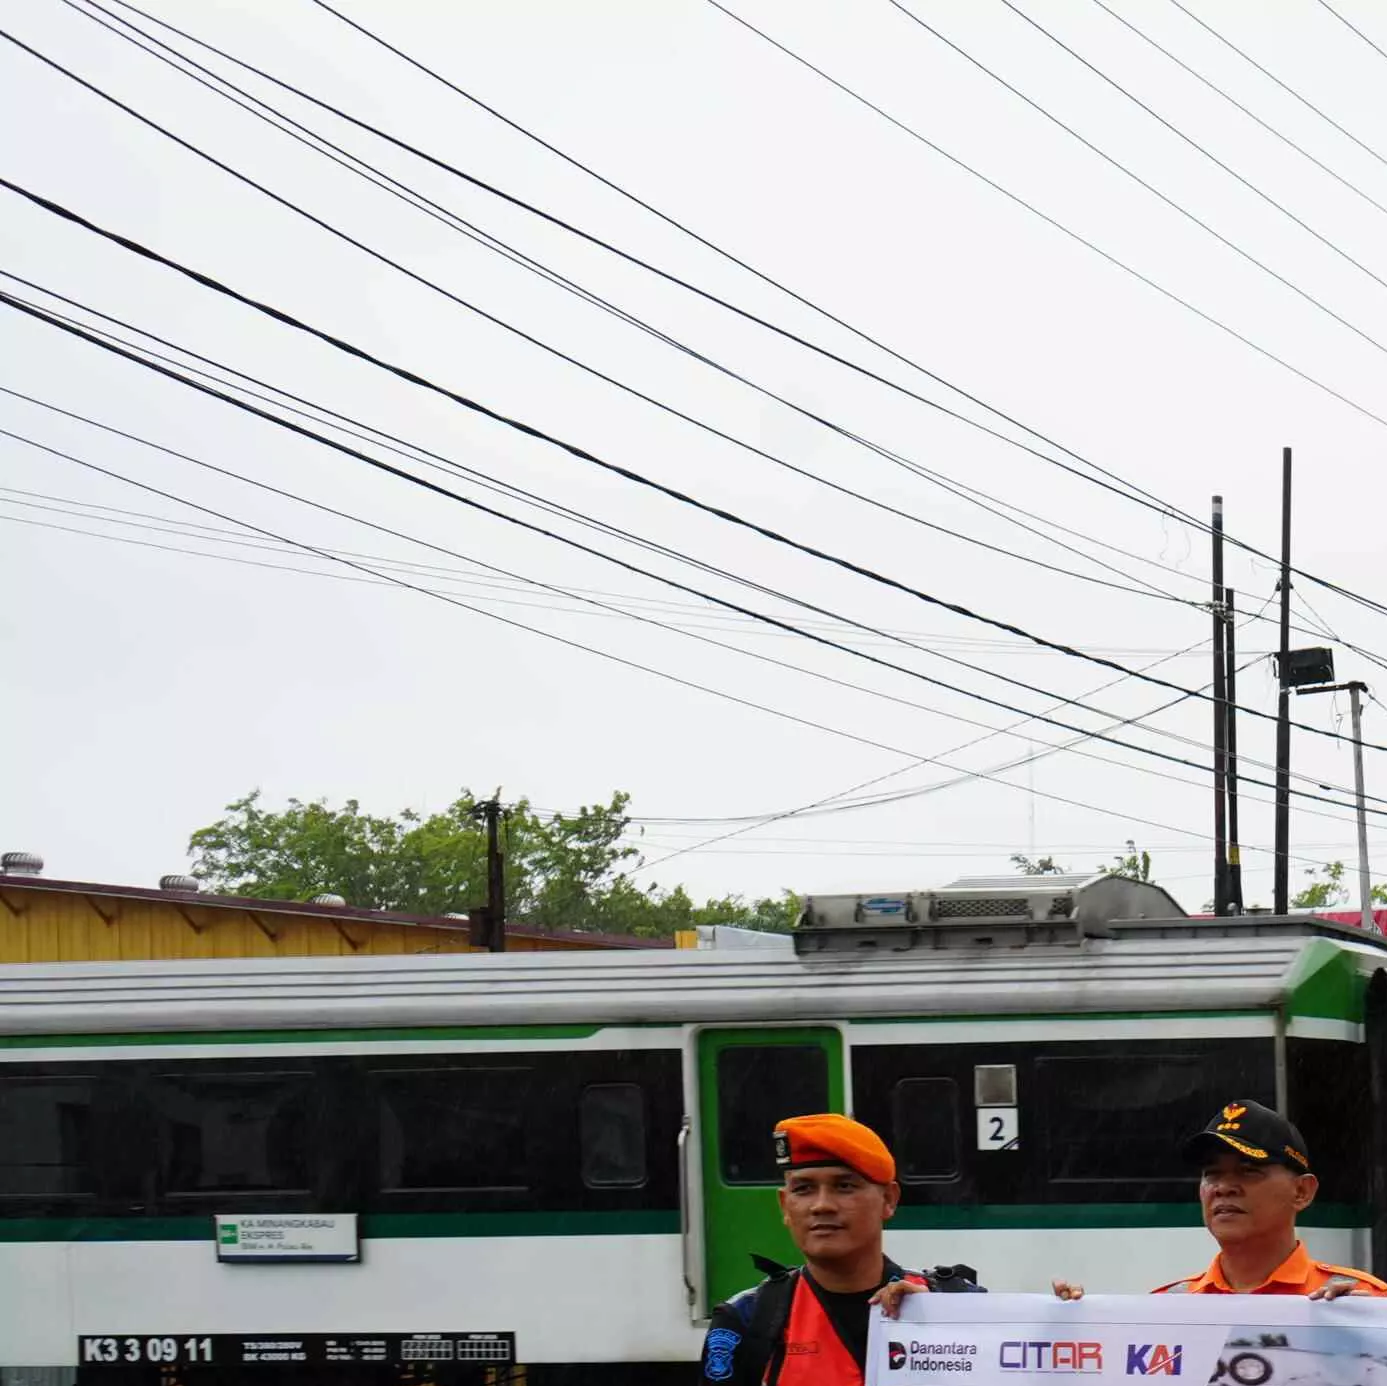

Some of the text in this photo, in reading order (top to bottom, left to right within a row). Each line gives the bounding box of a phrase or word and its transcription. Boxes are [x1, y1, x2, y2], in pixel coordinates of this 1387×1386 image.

[989, 1117, 1005, 1141] 2
[84, 1338, 212, 1362] K3 3 09 11
[909, 1341, 977, 1357] Danantara
[999, 1341, 1103, 1370] CITAR
[1126, 1343, 1183, 1376] KAI
[909, 1356, 973, 1373] Indonesia
